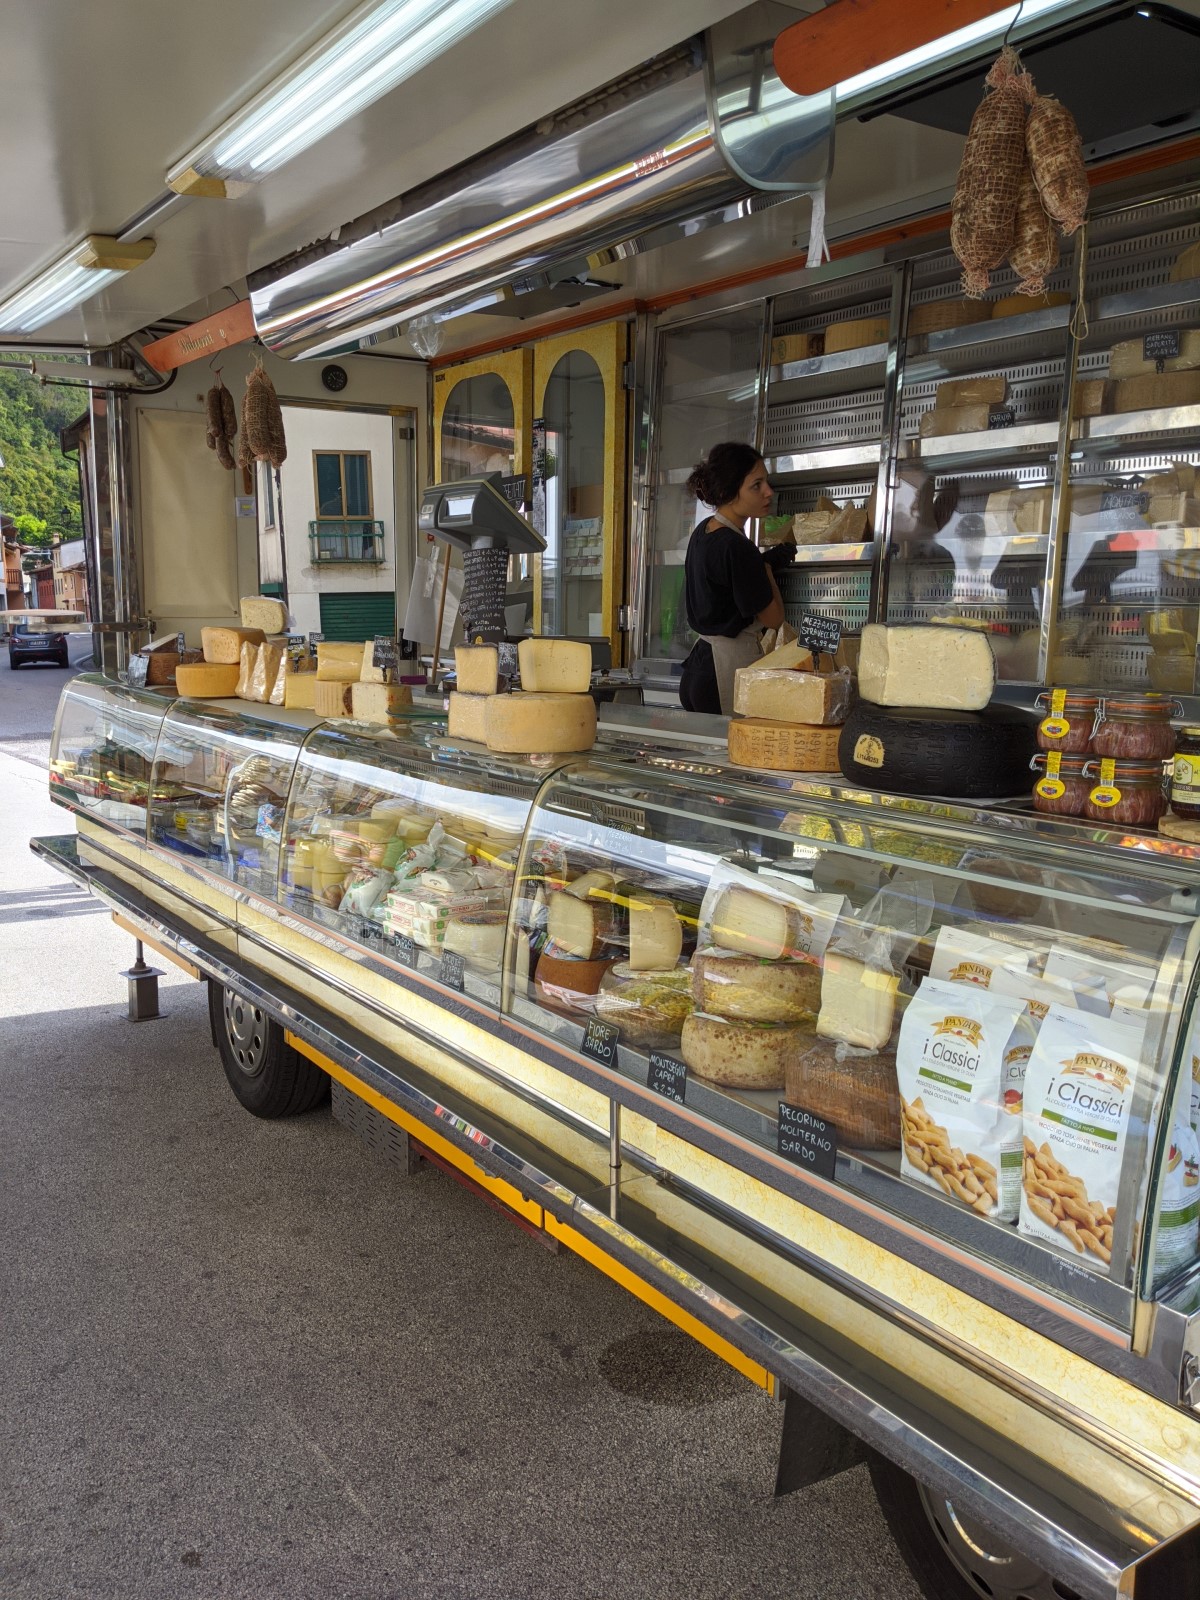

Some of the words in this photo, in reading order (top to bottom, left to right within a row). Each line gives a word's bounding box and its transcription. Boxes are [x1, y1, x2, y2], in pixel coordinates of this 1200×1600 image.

[588, 1020, 611, 1040] FIORE
[585, 1036, 611, 1057] SARDO
[923, 1038, 930, 1055] i
[932, 1041, 981, 1072] Classici
[654, 1068, 675, 1084] CAPRA
[1047, 1077, 1055, 1095] i
[1058, 1082, 1125, 1118] Classici
[780, 1103, 826, 1132] PECORINO
[780, 1123, 832, 1151] MOLITERNO
[1049, 1133, 1064, 1144] SENZA
[1083, 1145, 1099, 1155] PALMA
[1091, 1140, 1117, 1152] VEGETALE
[781, 1139, 816, 1161] SARDO
